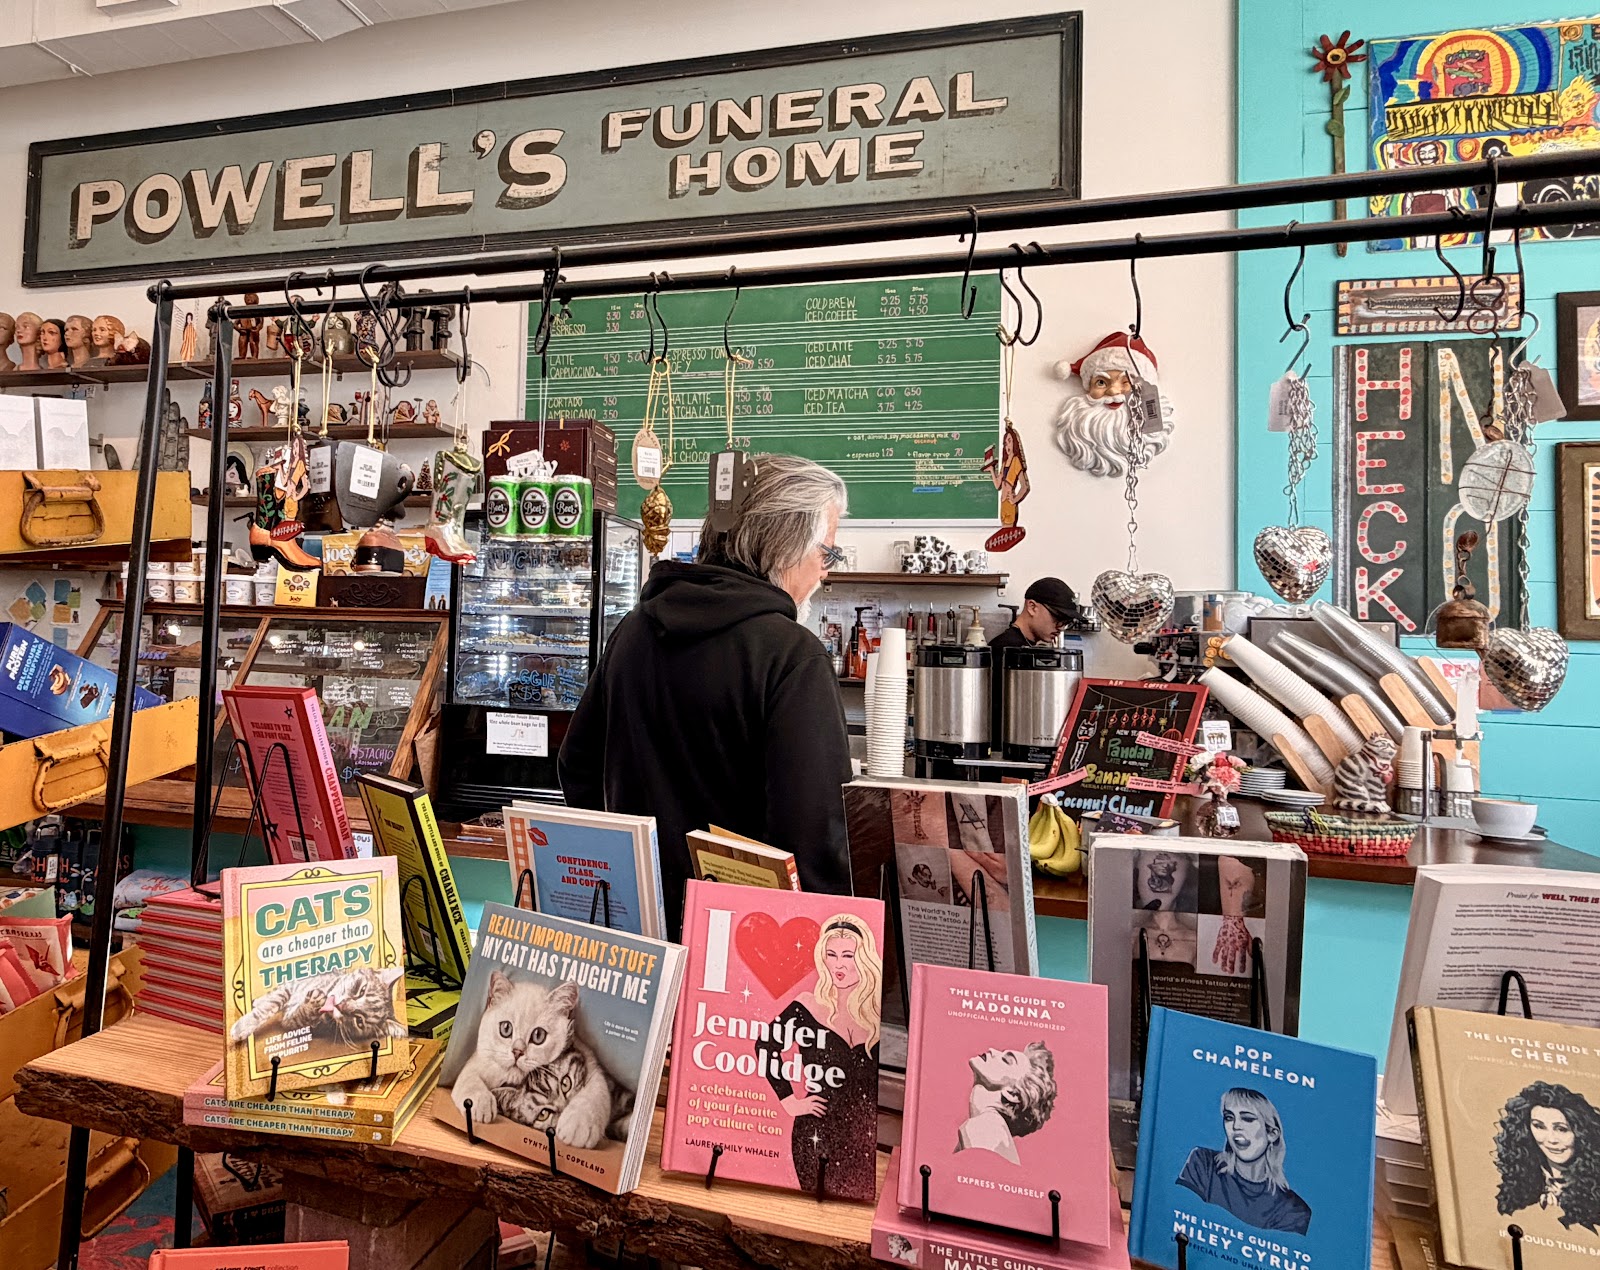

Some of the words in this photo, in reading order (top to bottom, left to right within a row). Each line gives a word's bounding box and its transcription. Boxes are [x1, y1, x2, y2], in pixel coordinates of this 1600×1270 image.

[600, 71, 1008, 155] FUNERAL
[668, 130, 925, 199] HOME
[70, 128, 567, 249] POWELL'S
[806, 297, 828, 310] COLD
[828, 296, 856, 309] BREW
[880, 295, 900, 305] 5.25
[909, 294, 929, 305] 5.75
[805, 311, 825, 322] ICED
[825, 309, 858, 321] COFFEE
[880, 306, 901, 317] 4.00
[908, 305, 929, 316] 4.50
[667, 348, 707, 361] ESPRESSO
[805, 342, 825, 353] ICED
[826, 341, 854, 352] LATTE
[878, 339, 898, 350] 5.25
[905, 338, 924, 348] 5.75
[550, 355, 575, 366] LATTE
[604, 353, 620, 364] 4.50
[757, 359, 774, 369] 5.50
[805, 357, 826, 368] ICED
[827, 355, 852, 367] CHAI
[877, 353, 897, 364] 5.25
[904, 352, 923, 363] 5.75
[550, 366, 596, 378] CAPPUCCINO
[548, 398, 583, 408] CORTADO
[684, 393, 711, 405] LATTE
[756, 391, 773, 401] 5.00
[804, 389, 825, 400] ICED
[825, 387, 869, 400] MATCHA
[876, 387, 896, 397] 6.00
[904, 387, 922, 396] 6.50
[548, 408, 597, 420] AMERICANO
[661, 406, 697, 418] MATCHA
[697, 405, 726, 417] LATTE
[756, 405, 773, 414] 6.00
[803, 403, 824, 414] ICED
[826, 402, 846, 414] TEA
[877, 402, 895, 412] 3.75
[904, 401, 923, 411] 4.25
[680, 437, 698, 449] TEA
[1355, 348, 1417, 633] HECK
[488, 501, 508, 514] Beer
[523, 501, 547, 514] Beer
[556, 501, 579, 514] Beer
[6, 644, 20, 671] PURE
[9, 639, 29, 681] PROTEIN
[16, 637, 40, 691] DELICIOUSLY
[265, 732, 277, 741] PONY
[273, 723, 281, 731] TO
[281, 724, 292, 732] THE
[1107, 738, 1154, 761] Pandan
[325, 767, 343, 811] CHAPPELL
[337, 811, 350, 841] ROAN
[1055, 790, 1107, 812] Coconut
[1108, 795, 1154, 816] Cloud
[556, 855, 611, 871] CONFIDENCE,
[561, 876, 577, 885] AND
[440, 868, 457, 906] CHARLI
[450, 903, 463, 925] XCX
[1528, 894, 1540, 902] for
[1568, 895, 1590, 904] THIS
[255, 884, 372, 937] CATS
[907, 905, 922, 914] The
[921, 906, 946, 916] World's
[947, 909, 960, 919] Top
[908, 912, 922, 920] Fine
[923, 913, 938, 922] Line
[939, 915, 961, 925] Tattoo
[262, 945, 283, 959] are
[288, 933, 338, 957] cheaper
[342, 924, 370, 940] than
[488, 913, 531, 945] REALLY
[529, 924, 608, 964] IMPORTANT
[607, 944, 658, 977] STUFF
[698, 908, 736, 995] I
[259, 944, 374, 986] THERAPY
[481, 936, 502, 960] MY
[501, 937, 530, 968] CAT
[527, 950, 559, 980] HAS
[559, 957, 624, 1001] TAUGHT
[621, 972, 652, 1005] ME
[1152, 975, 1179, 985] World's
[1180, 977, 1204, 987] Finest
[1204, 979, 1229, 988] Tattoo
[949, 987, 970, 998] THE
[973, 990, 1010, 1002] LITTLE
[1013, 996, 1047, 1008] GUIDE
[1050, 1000, 1066, 1010] TO
[961, 998, 1052, 1021] MADONNA
[692, 1002, 830, 1051] Jennifer
[947, 1010, 989, 1023] UNOFFICIAL
[990, 1016, 1006, 1024] AND
[1008, 1018, 1066, 1032] UNAUTHORIZED
[264, 1042, 285, 1054] FROM
[286, 1034, 312, 1047] FELINE
[265, 1034, 281, 1045] LIFE
[282, 1026, 310, 1041] ADVICE
[1463, 1030, 1492, 1043] THE
[1495, 1034, 1541, 1049] LITTLE
[1546, 1042, 1589, 1056] GUIDE
[1235, 1044, 1273, 1062] POP
[1511, 1047, 1569, 1066] CHER
[693, 1041, 847, 1094] Coolidge
[1192, 1048, 1316, 1089] CHAMELEON
[690, 1083, 698, 1093] a
[700, 1083, 767, 1102] celebration
[205, 1098, 227, 1108] CATS
[227, 1100, 246, 1109] ARE
[247, 1101, 287, 1112] CHEAPER
[288, 1105, 313, 1115] THAN
[314, 1107, 355, 1119] THERAPY
[688, 1097, 703, 1110] of
[703, 1101, 731, 1116] your
[732, 1102, 778, 1120] favorite
[205, 1114, 227, 1124] CATS
[228, 1117, 246, 1126] ARE
[247, 1119, 287, 1131] CHEAPER
[288, 1123, 312, 1134] THAN
[312, 1125, 354, 1137] THERAPY
[687, 1113, 710, 1128] pop
[712, 1115, 754, 1132] culture
[757, 1123, 783, 1136] icon
[685, 1138, 718, 1150] LAUREN
[718, 1143, 743, 1154] EMILY
[744, 1147, 780, 1159] WHALEN
[566, 1153, 606, 1175] COPELAND
[957, 1175, 996, 1190] EXPRESS
[998, 1183, 1046, 1200] YOURSELF
[1173, 1221, 1232, 1250] MILEY
[1173, 1209, 1198, 1225] THE
[1201, 1219, 1245, 1241] LITTLE
[1248, 1235, 1289, 1256] GUIDE
[1293, 1250, 1312, 1263] TO
[929, 1244, 953, 1258] THE
[958, 1250, 998, 1267] LITTLE
[1556, 1240, 1587, 1254] TURN
[1220, 1253, 1239, 1265] AND
